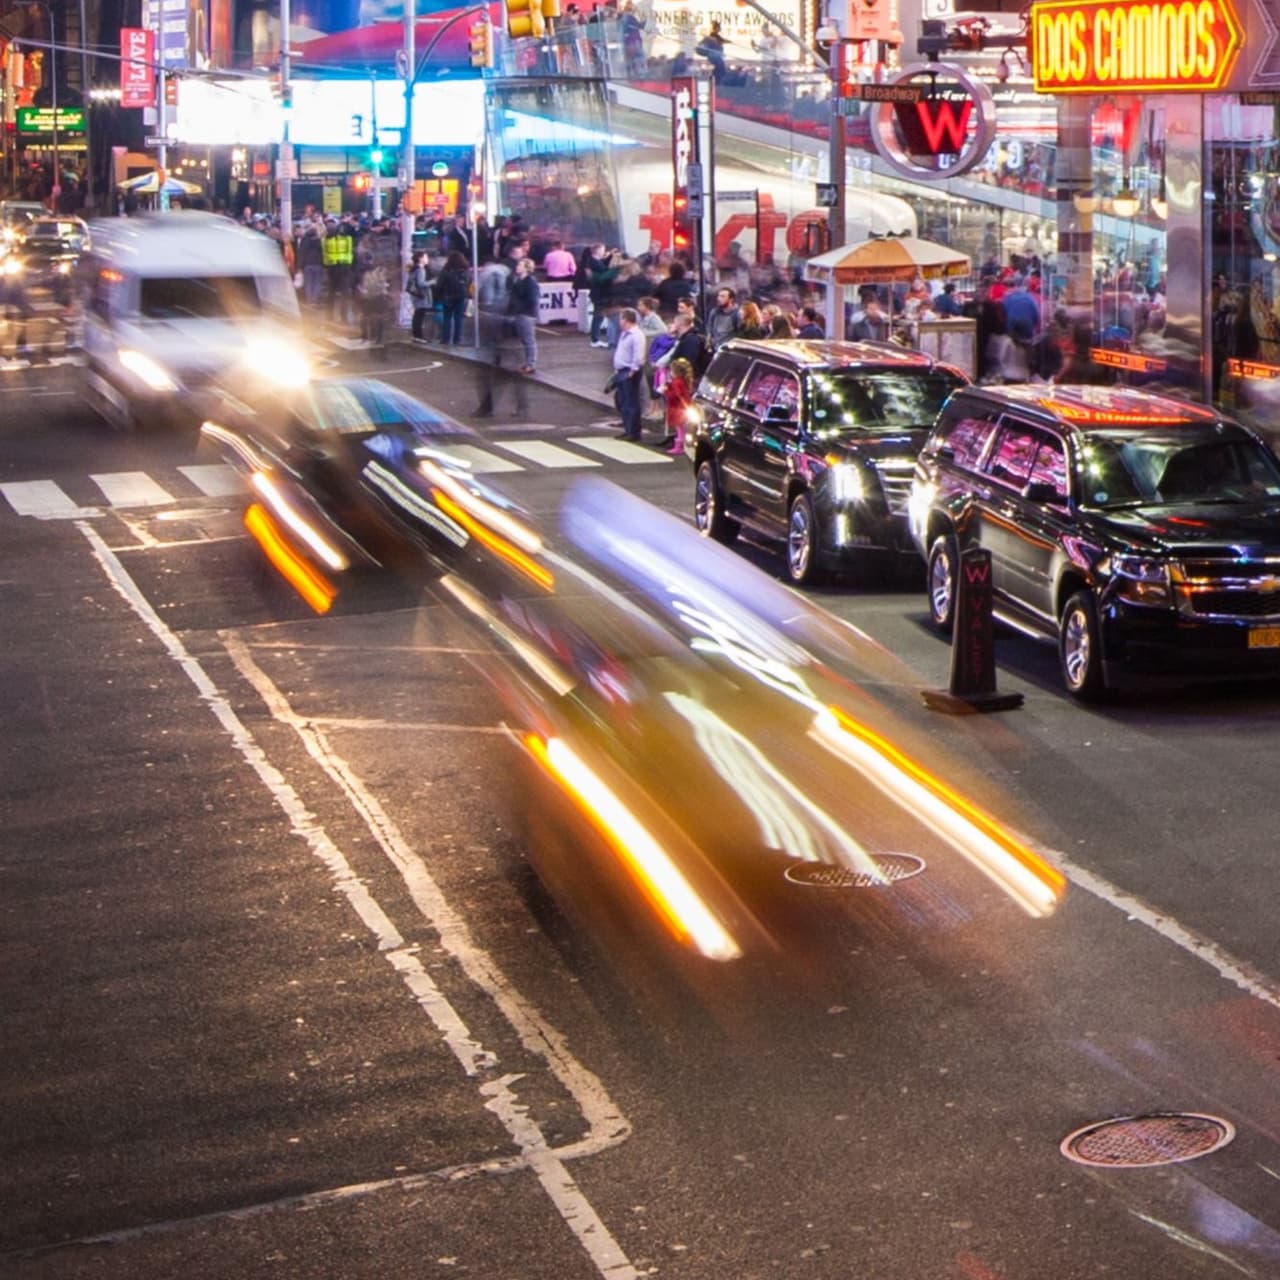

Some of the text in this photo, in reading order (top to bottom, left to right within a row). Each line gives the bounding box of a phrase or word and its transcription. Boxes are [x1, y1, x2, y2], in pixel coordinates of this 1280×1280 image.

[708, 10, 739, 26] TONY
[1038, 0, 1217, 82] DOS CAMINOS
[863, 85, 921, 103] Broadway
[916, 100, 974, 153] W
[965, 565, 989, 583] W
